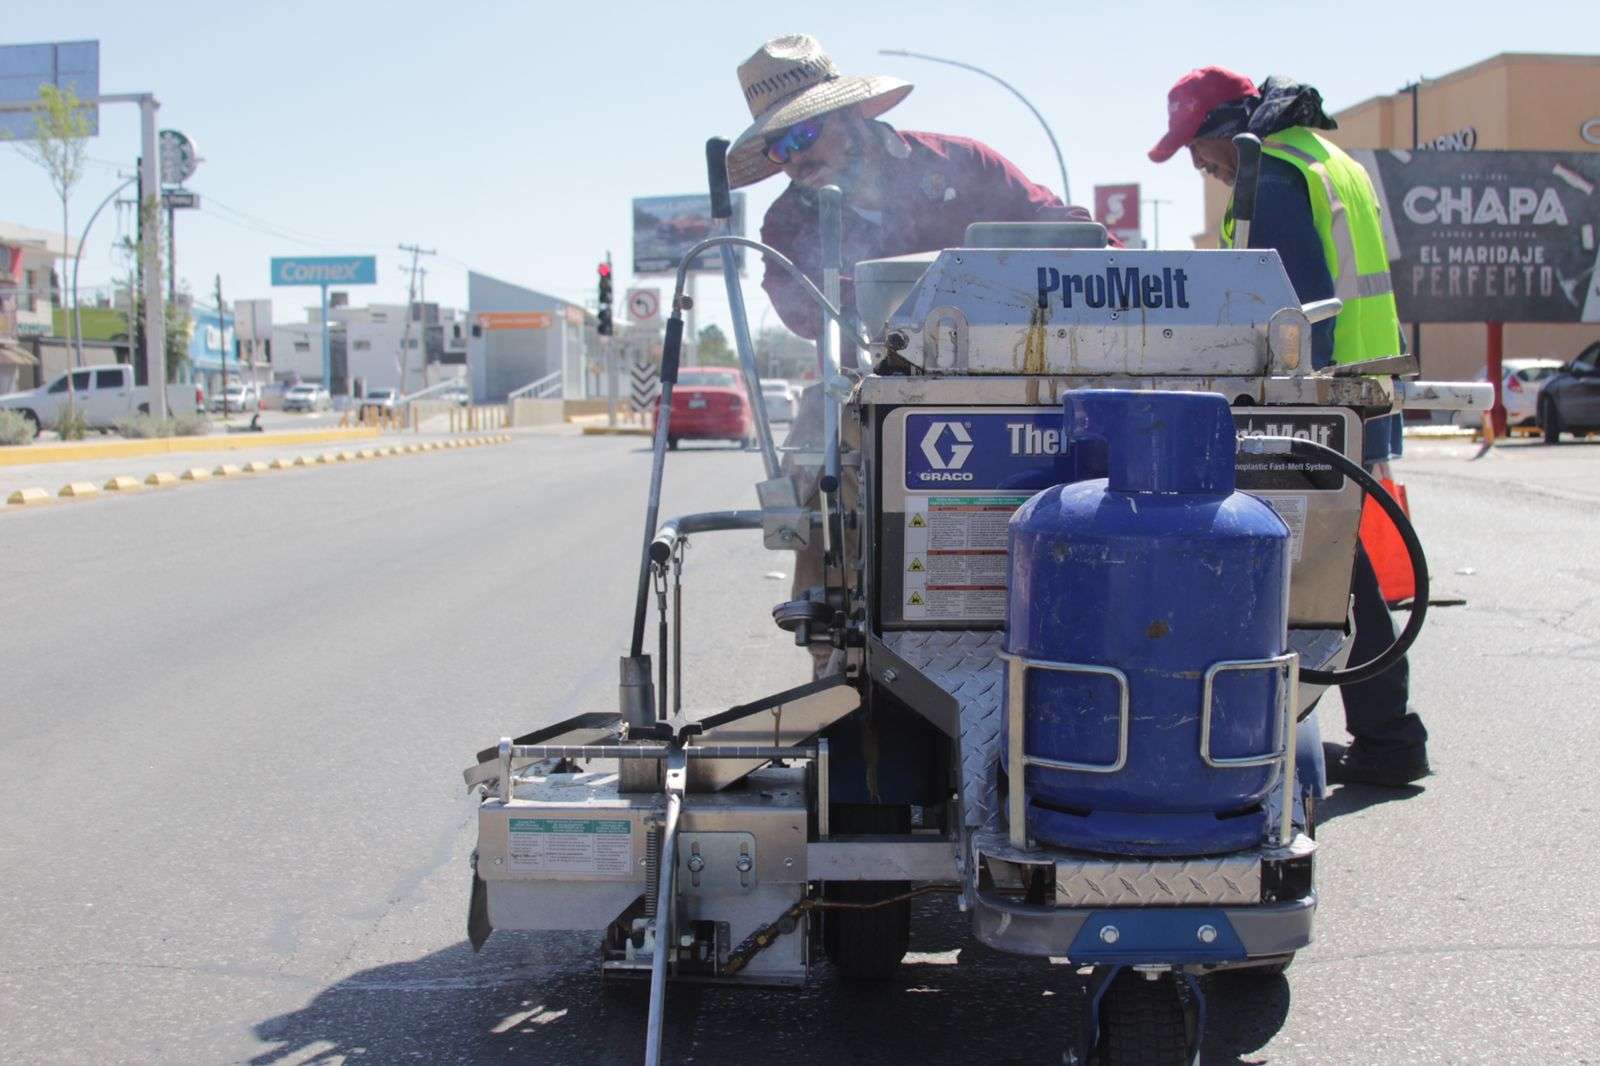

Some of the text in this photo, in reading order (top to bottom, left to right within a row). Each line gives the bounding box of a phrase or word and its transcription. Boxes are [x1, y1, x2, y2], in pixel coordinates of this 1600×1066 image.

[1403, 186, 1568, 225] CHAPA
[1421, 246, 1545, 264] EL MARIDAJE
[281, 260, 361, 281] Comex
[1037, 266, 1190, 309] ProMelt
[1413, 266, 1552, 297] PERFECTO
[920, 472, 974, 481] GRACO
[1305, 462, 1333, 472] System
